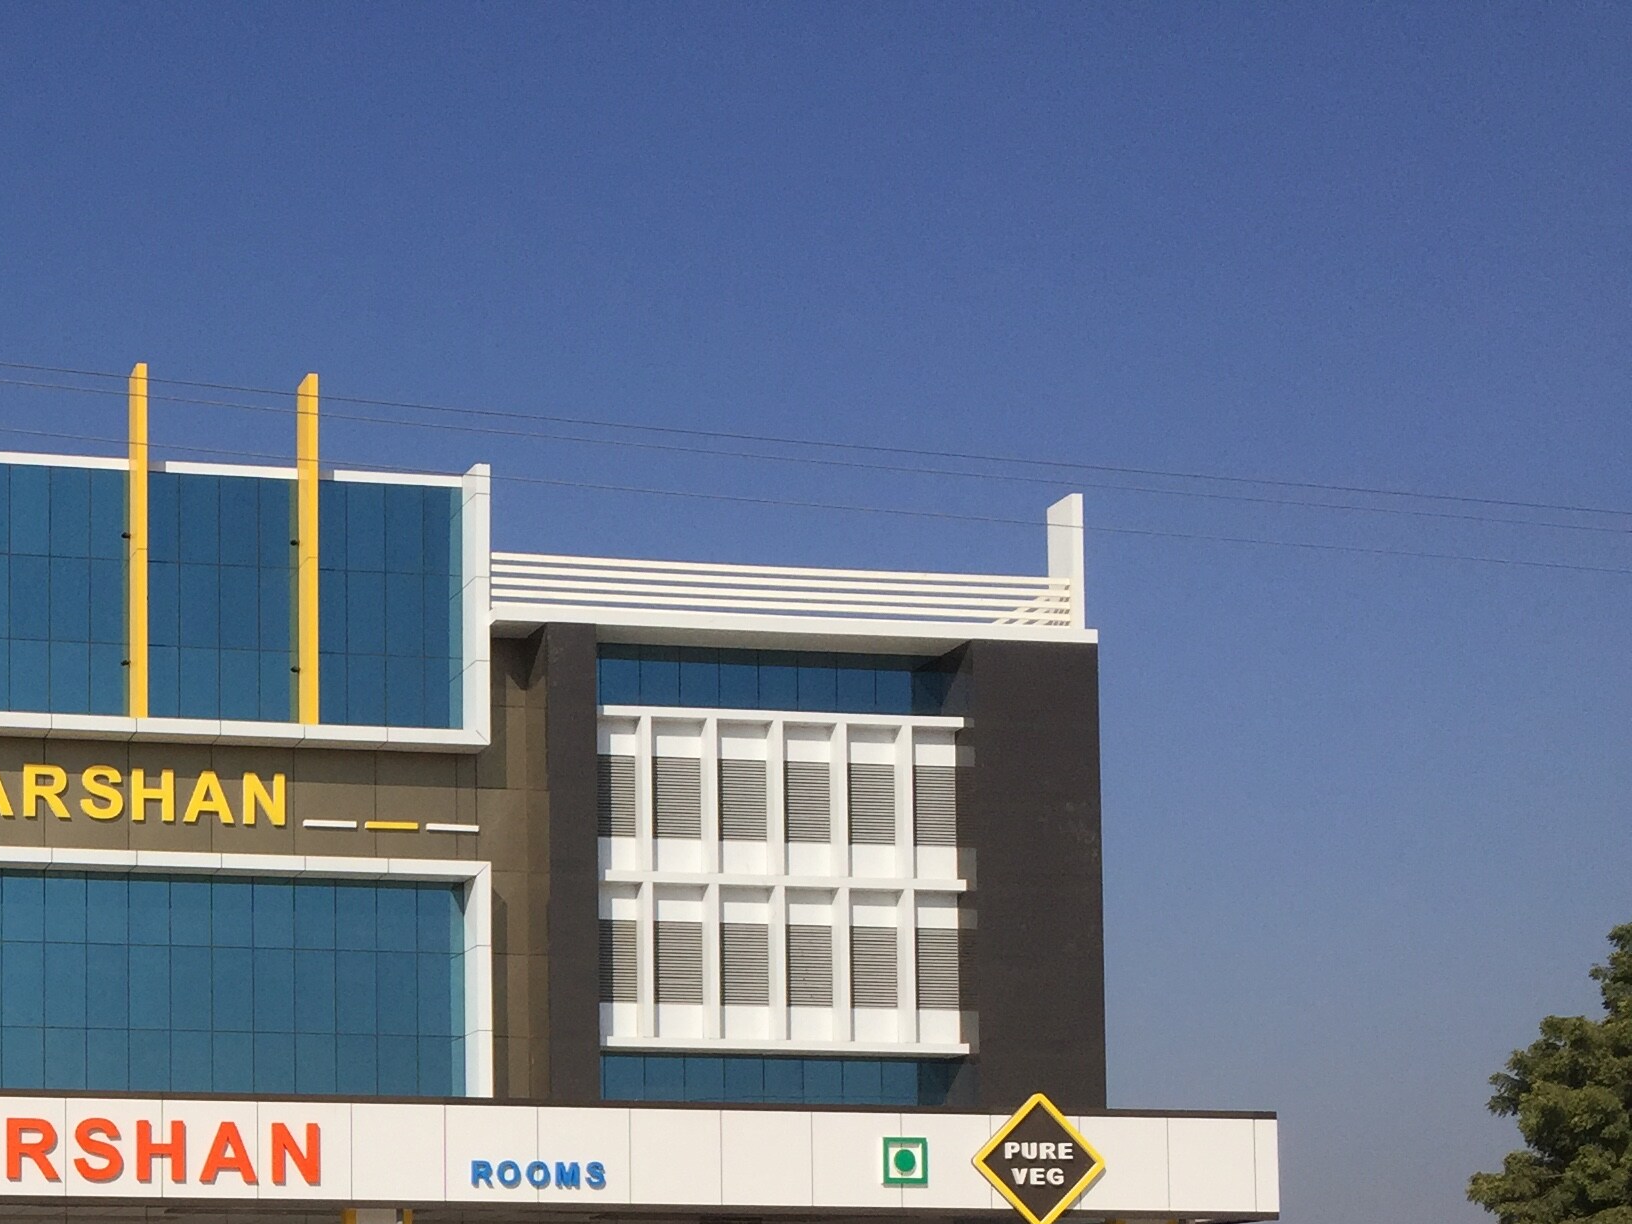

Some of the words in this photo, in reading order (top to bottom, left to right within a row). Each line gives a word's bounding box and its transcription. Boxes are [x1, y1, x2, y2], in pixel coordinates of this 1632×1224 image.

[1004, 1141, 1074, 1160] PURE
[471, 1159, 607, 1190] ROOMS
[1010, 1167, 1065, 1186] VEG
